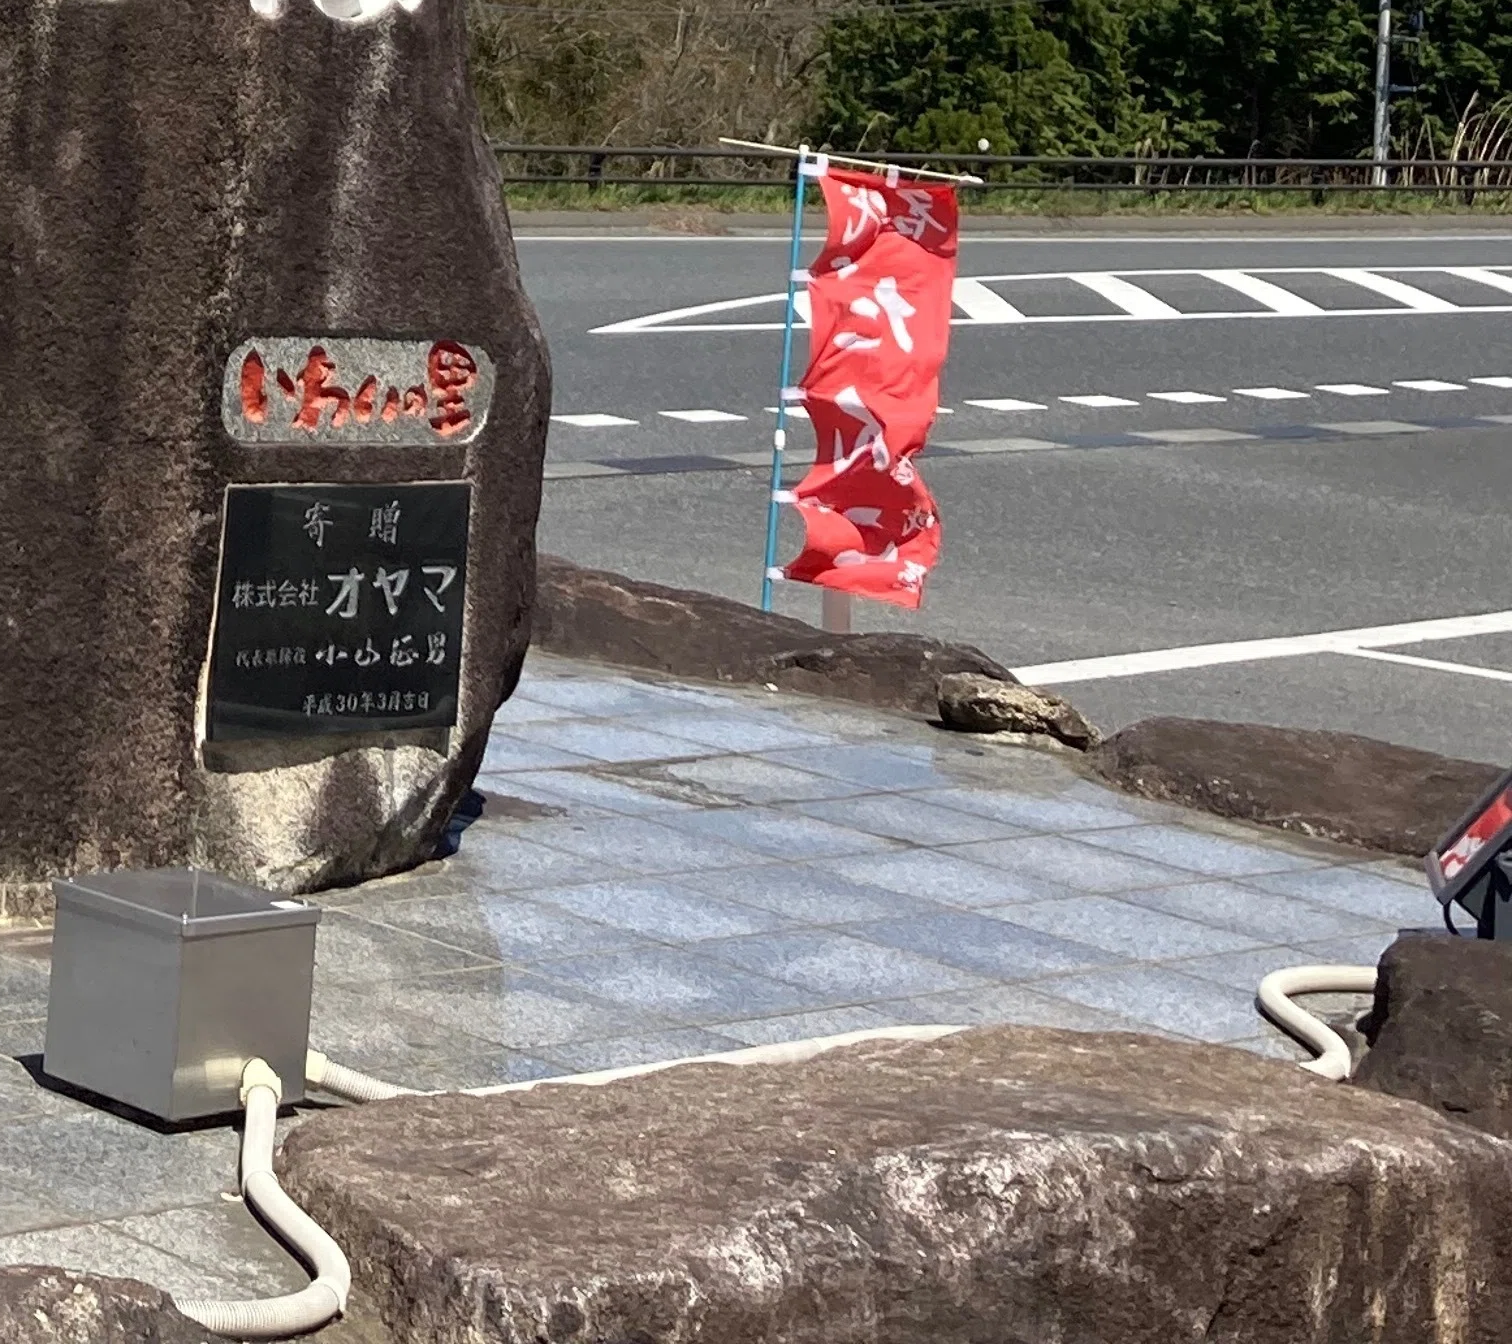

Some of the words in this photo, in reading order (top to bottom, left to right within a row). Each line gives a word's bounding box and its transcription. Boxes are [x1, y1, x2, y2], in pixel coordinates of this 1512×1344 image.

[302, 499, 402, 549] 寄贈
[231, 578, 320, 609] 株式会社
[325, 565, 458, 618] オヤマ
[302, 690, 431, 717] 平成30年3月吉日
